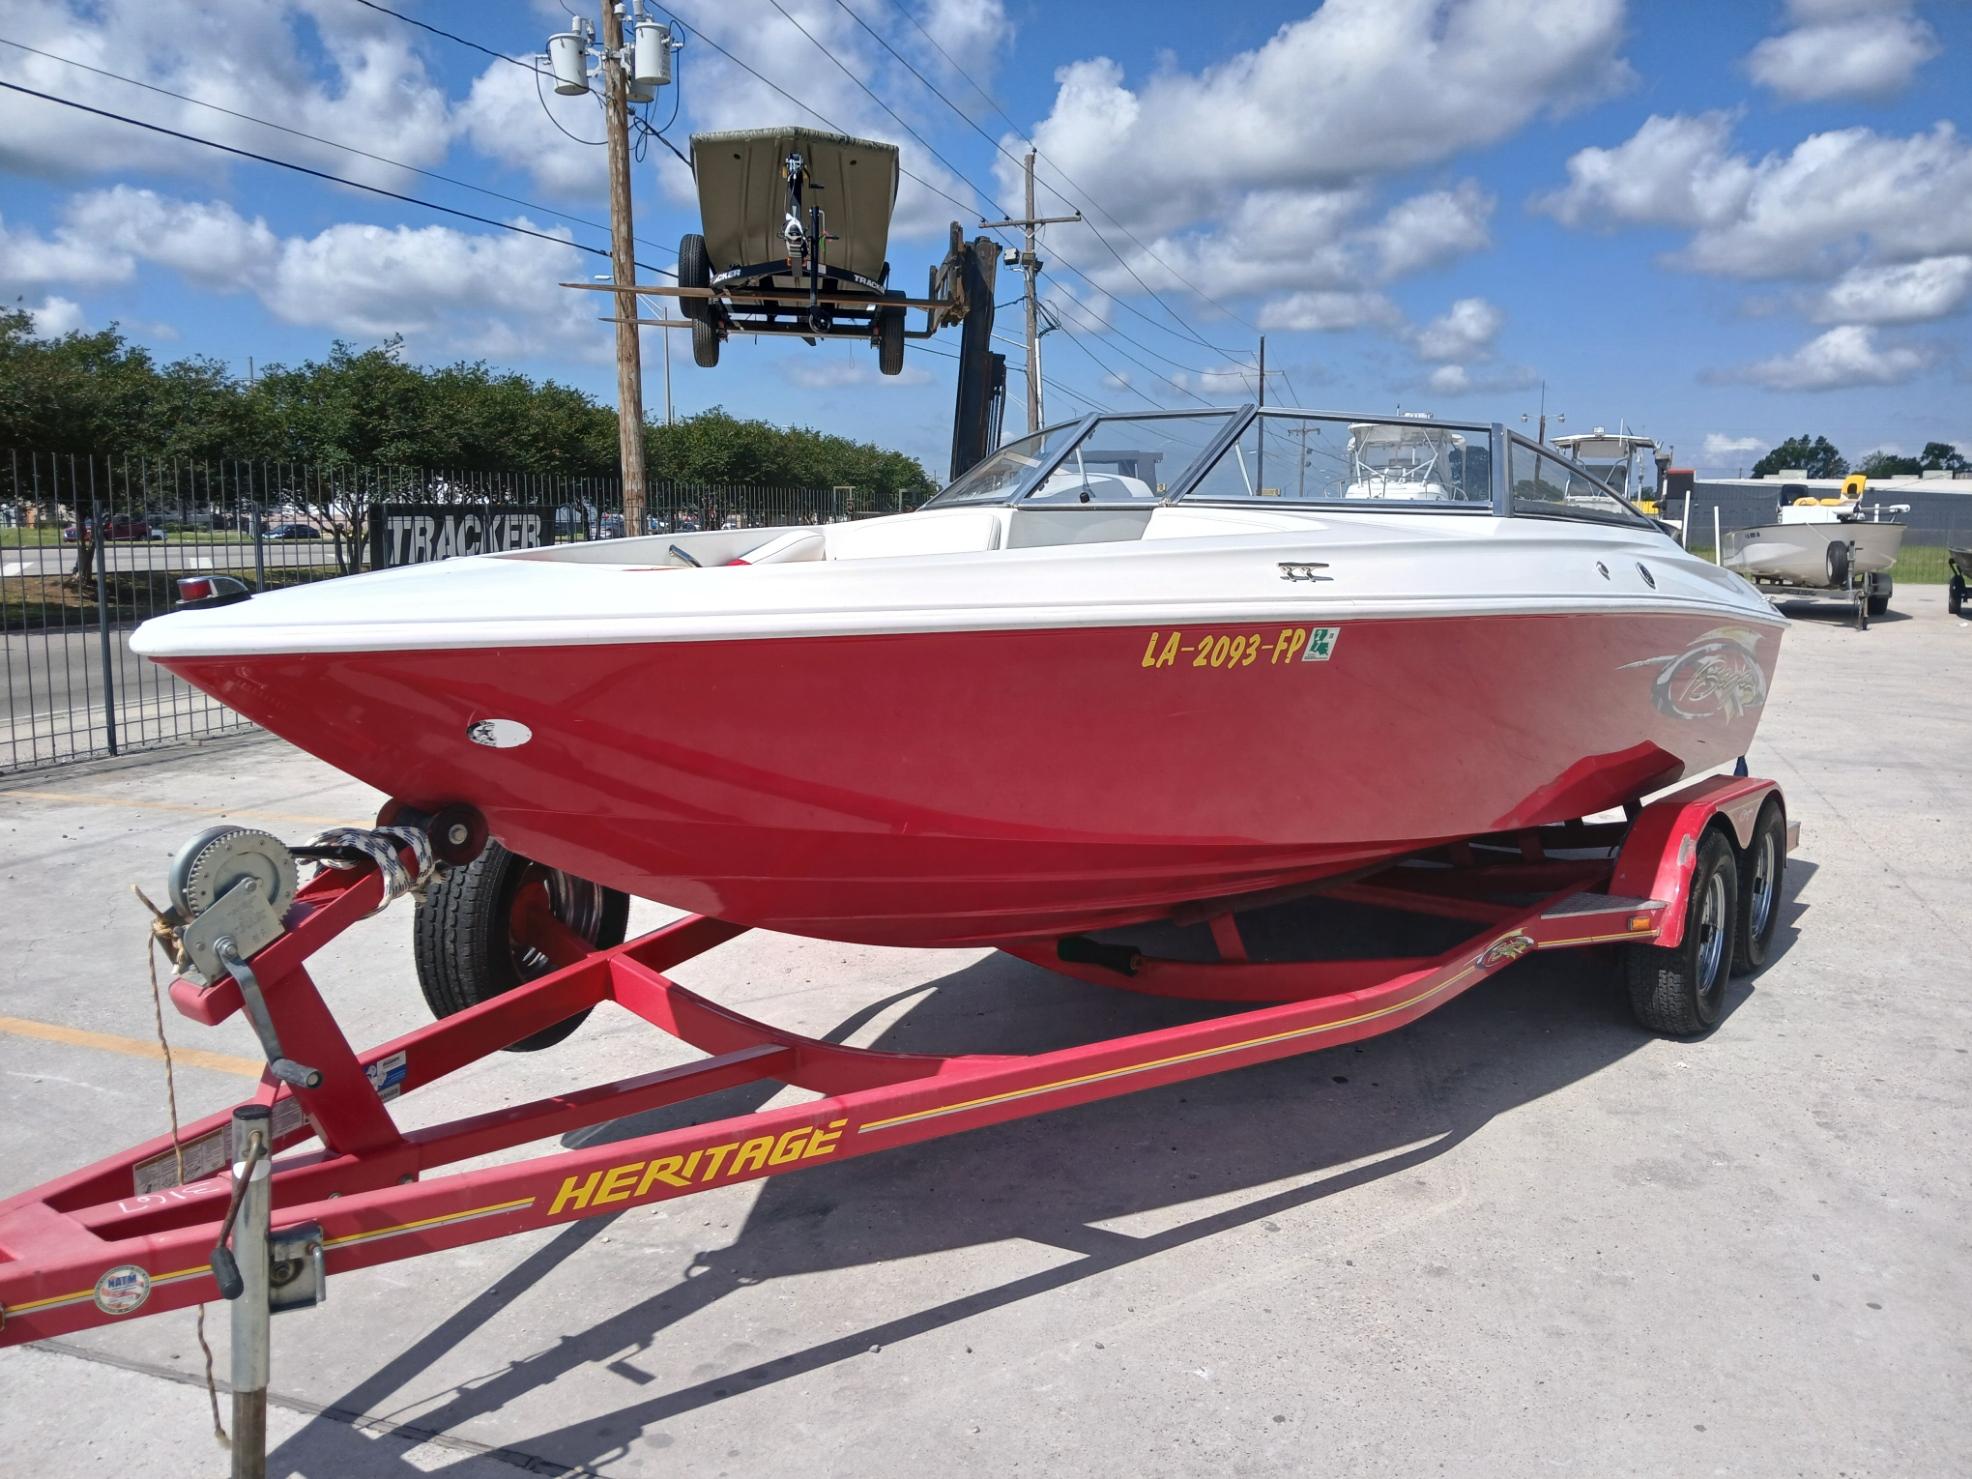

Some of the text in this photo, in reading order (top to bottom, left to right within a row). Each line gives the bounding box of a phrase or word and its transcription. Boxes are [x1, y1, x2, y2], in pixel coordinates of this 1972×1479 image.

[386, 513, 543, 566] TRACKER
[1141, 628, 1307, 669] LA-2093-FP
[547, 1117, 849, 1216] HERITAGE
